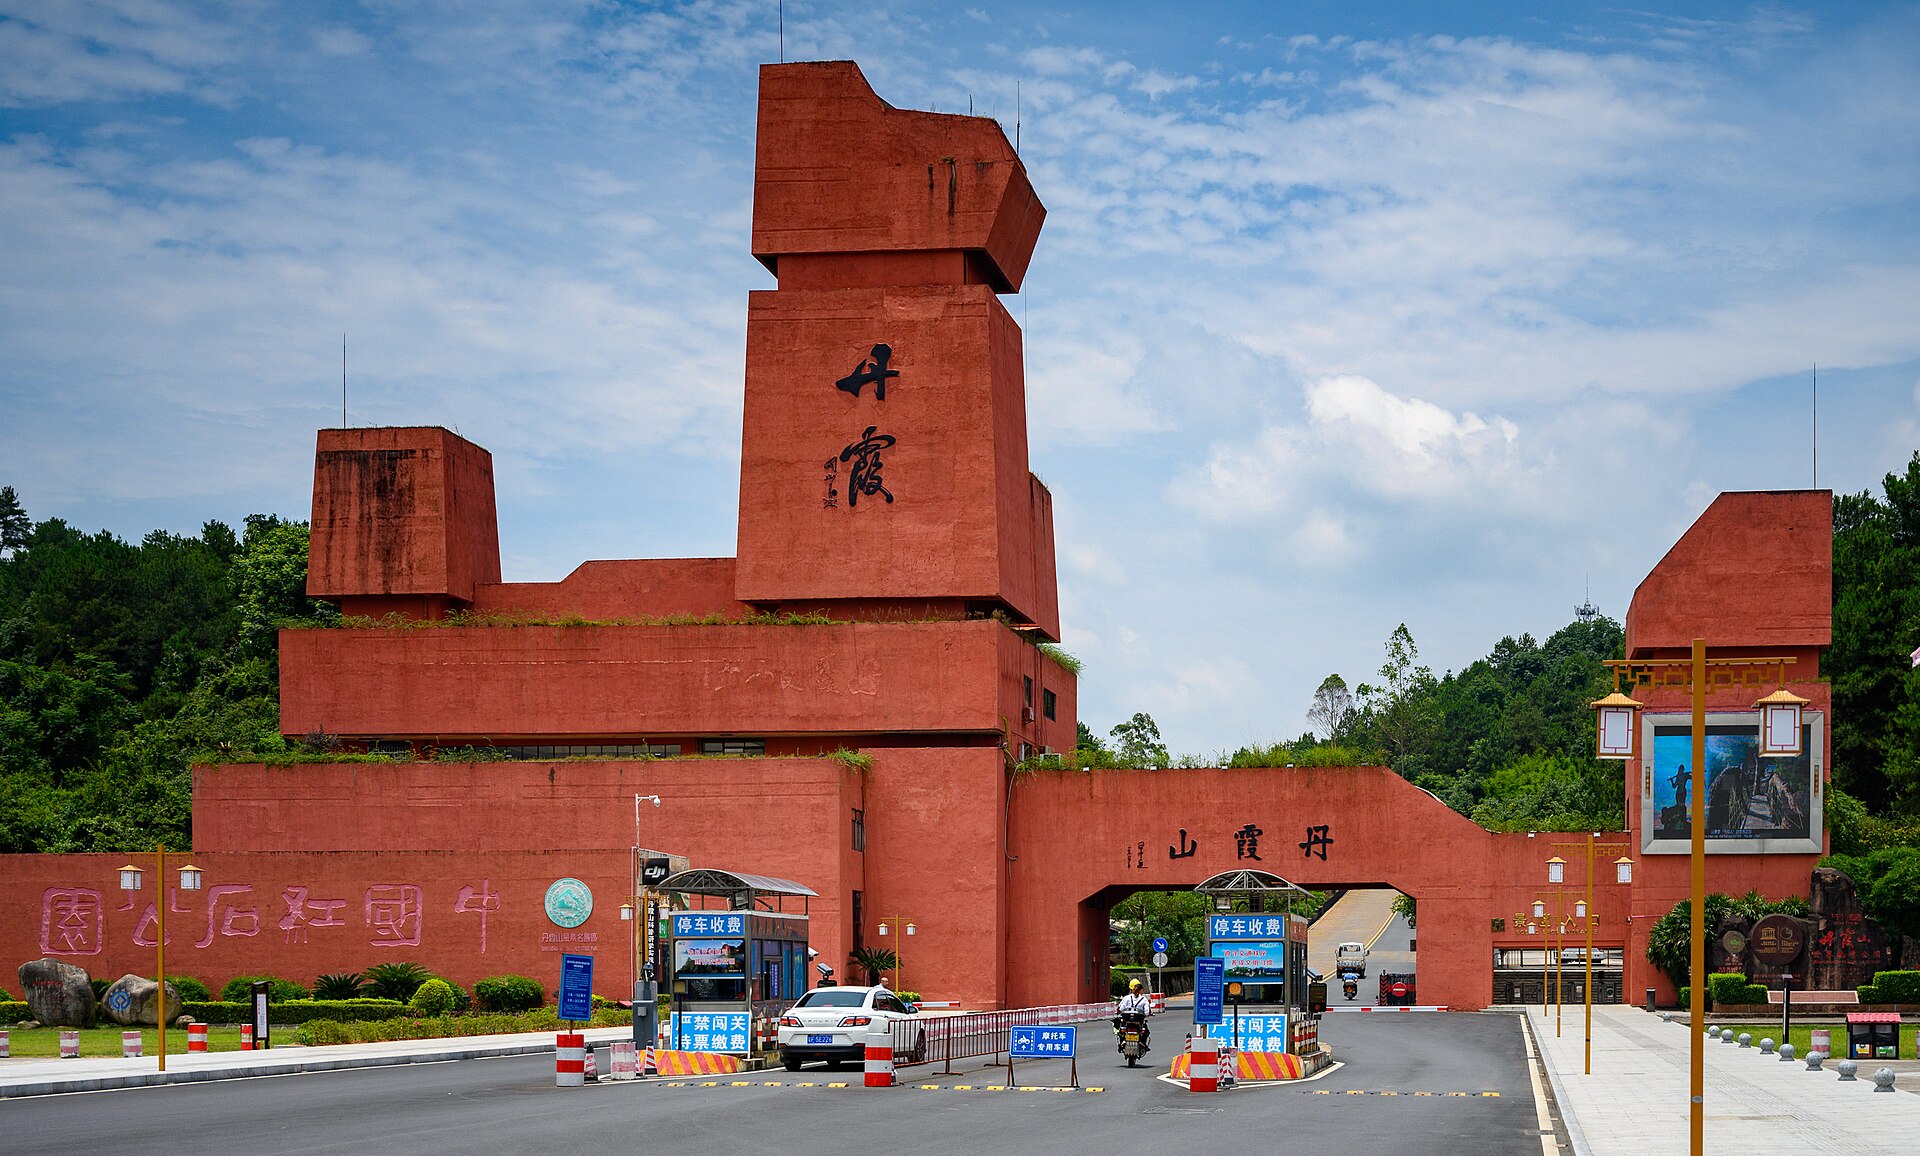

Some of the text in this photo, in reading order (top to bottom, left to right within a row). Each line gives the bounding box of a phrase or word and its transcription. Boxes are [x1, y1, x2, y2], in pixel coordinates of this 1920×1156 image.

[677, 916, 741, 933] 停车收费
[1214, 919, 1280, 935] 停车收费
[675, 1015, 746, 1031] 严禁闯关
[675, 1034, 745, 1050] 持票缴费
[1041, 1031, 1066, 1040] 摩托车
[1037, 1043, 1070, 1051] 专用车道
